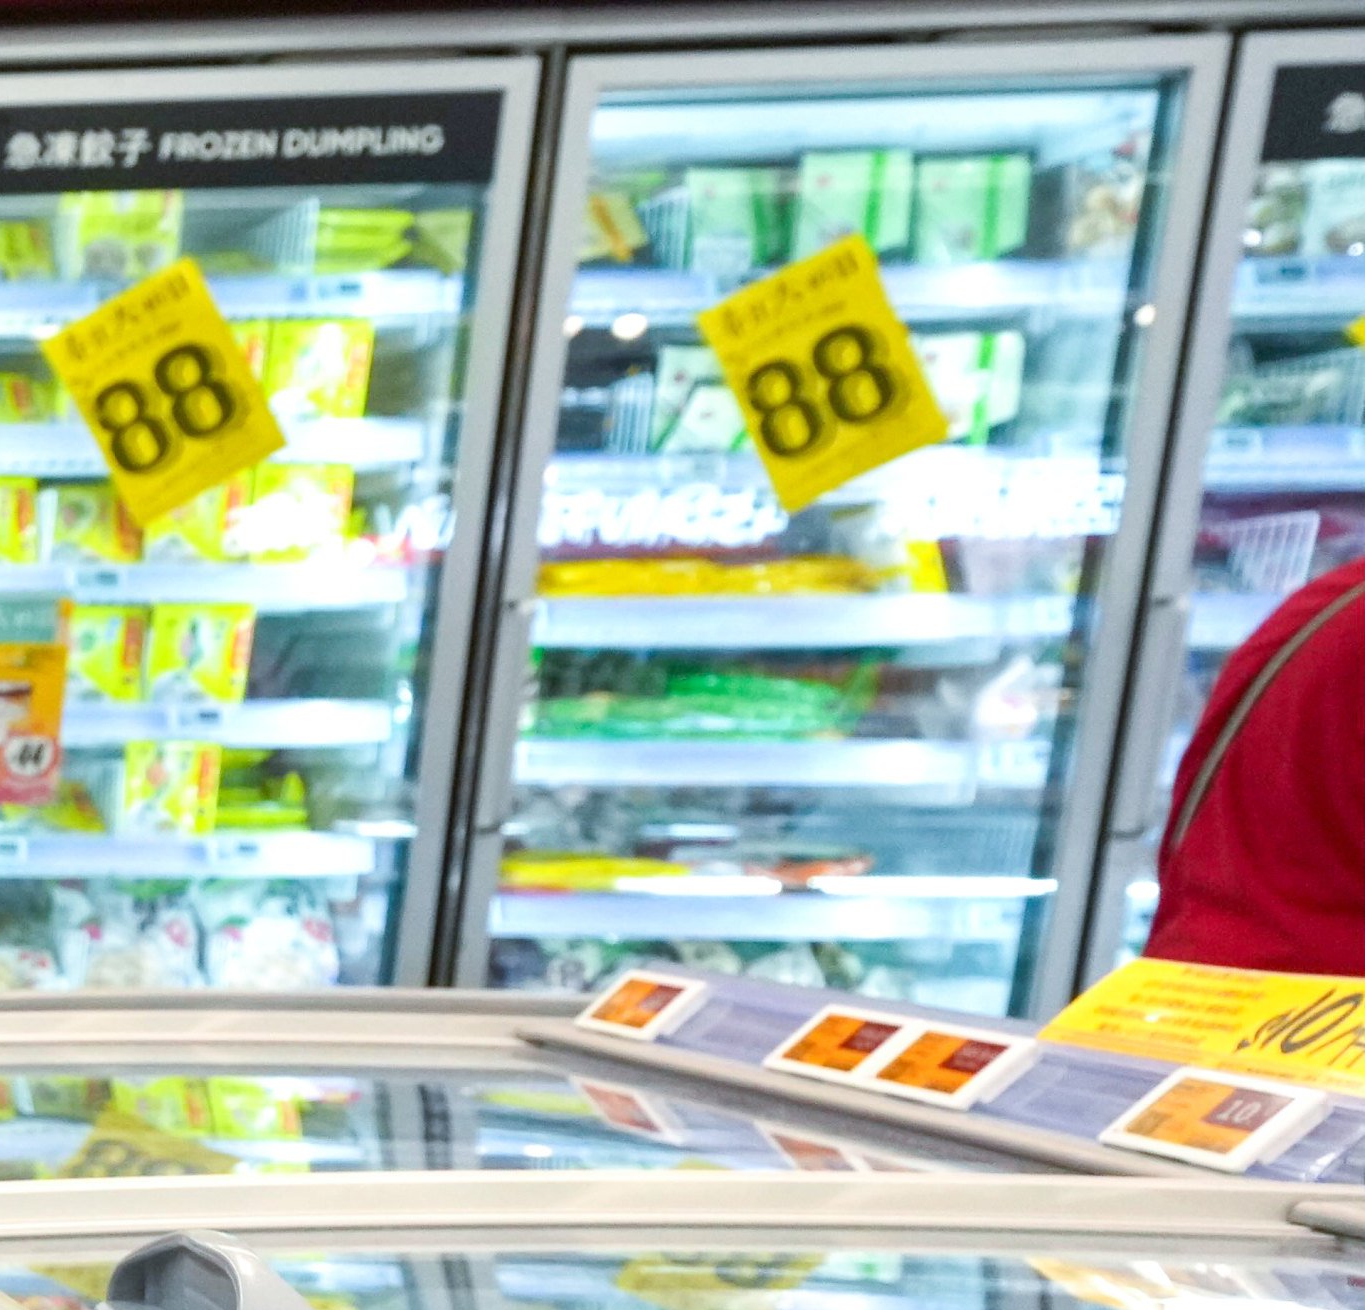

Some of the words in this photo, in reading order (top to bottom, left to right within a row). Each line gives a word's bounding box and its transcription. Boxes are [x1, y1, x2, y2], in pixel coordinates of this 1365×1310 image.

[5, 127, 152, 171] 急凍餃子
[157, 129, 278, 163] FROZEN
[281, 123, 445, 159] DUMPLING
[92, 342, 236, 474] 88
[744, 321, 899, 459] 88
